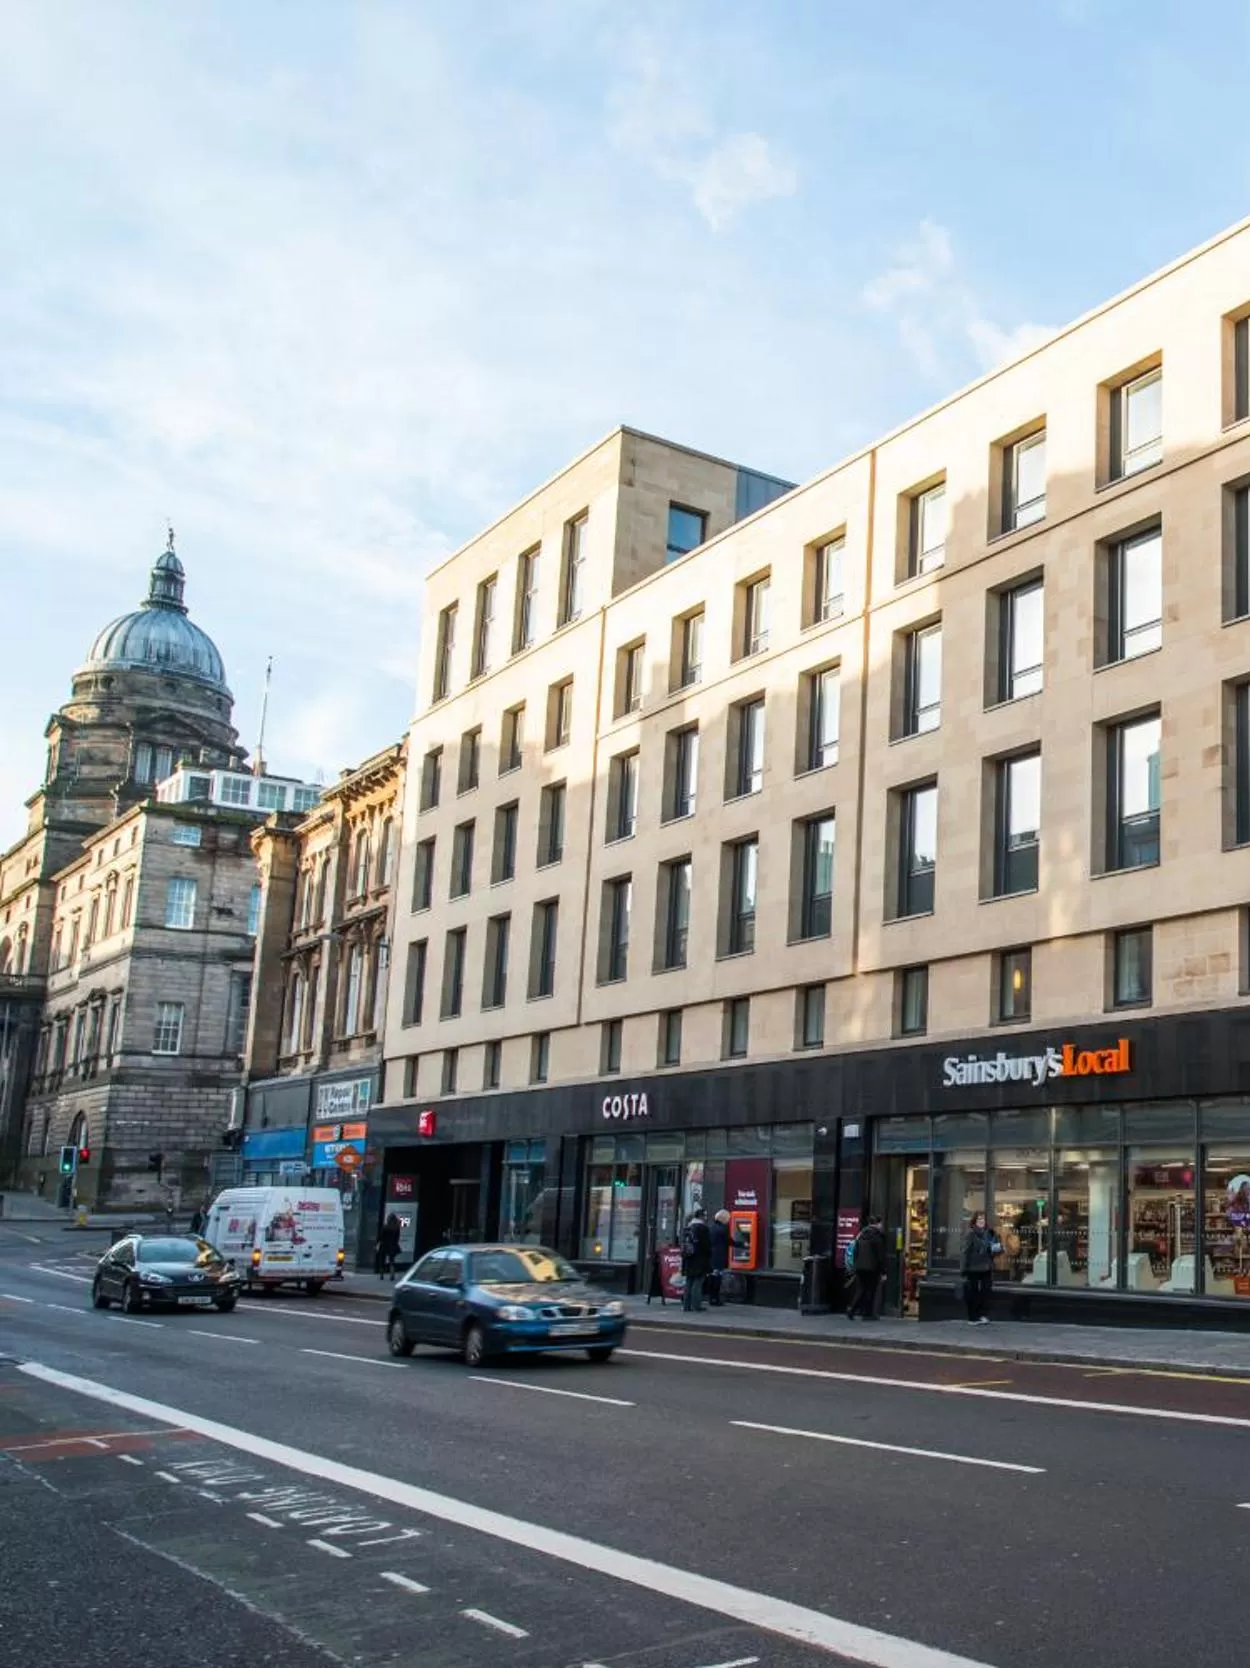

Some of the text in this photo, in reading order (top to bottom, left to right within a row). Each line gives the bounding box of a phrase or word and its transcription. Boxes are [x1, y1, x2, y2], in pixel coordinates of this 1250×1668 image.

[943, 1038, 1130, 1087] Sainsbury's Local
[602, 1092, 648, 1120] COSTA
